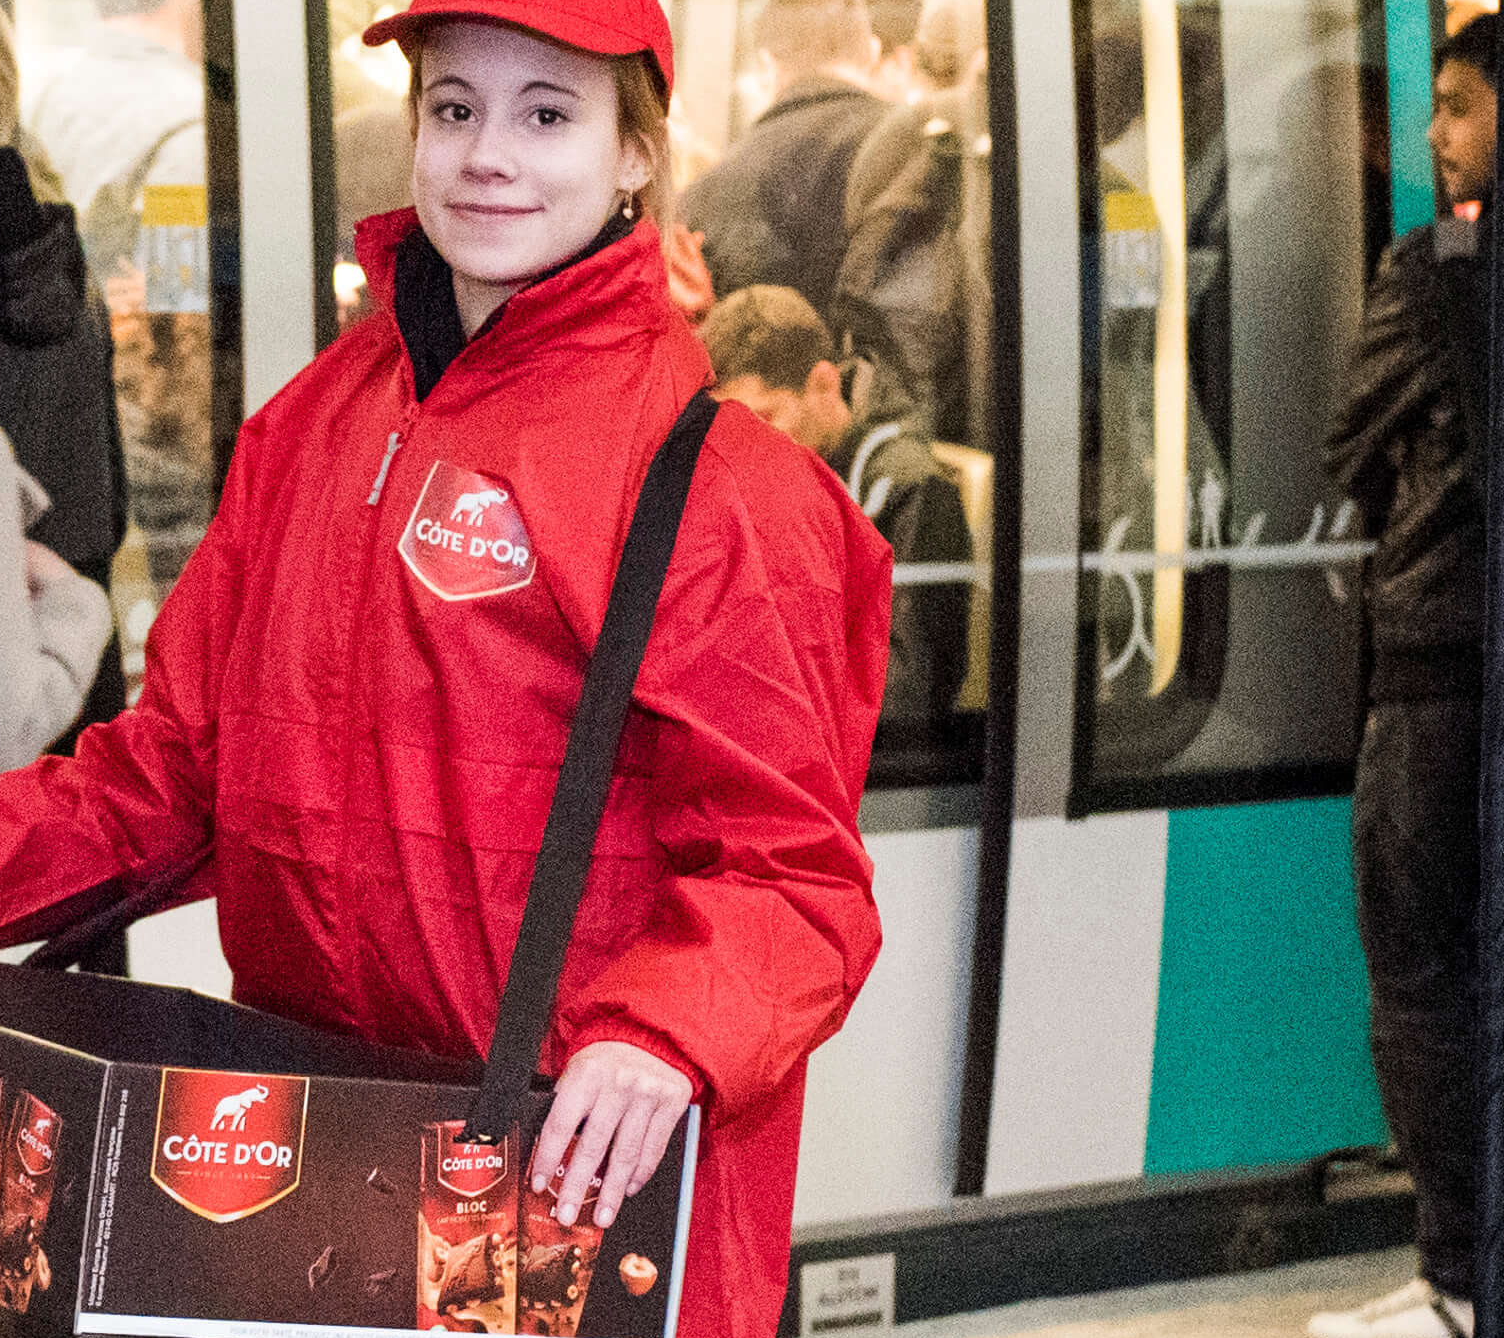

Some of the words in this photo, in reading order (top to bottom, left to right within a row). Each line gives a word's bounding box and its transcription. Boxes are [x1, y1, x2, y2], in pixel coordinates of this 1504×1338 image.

[416, 518, 464, 553] CÔTE
[469, 537, 529, 567] D'OR
[163, 1134, 228, 1164] CÔTE
[233, 1140, 292, 1168] D'OR
[443, 1156, 472, 1172] CÔTE
[475, 1155, 503, 1170] D'OR
[456, 1201, 487, 1214] BLOC
